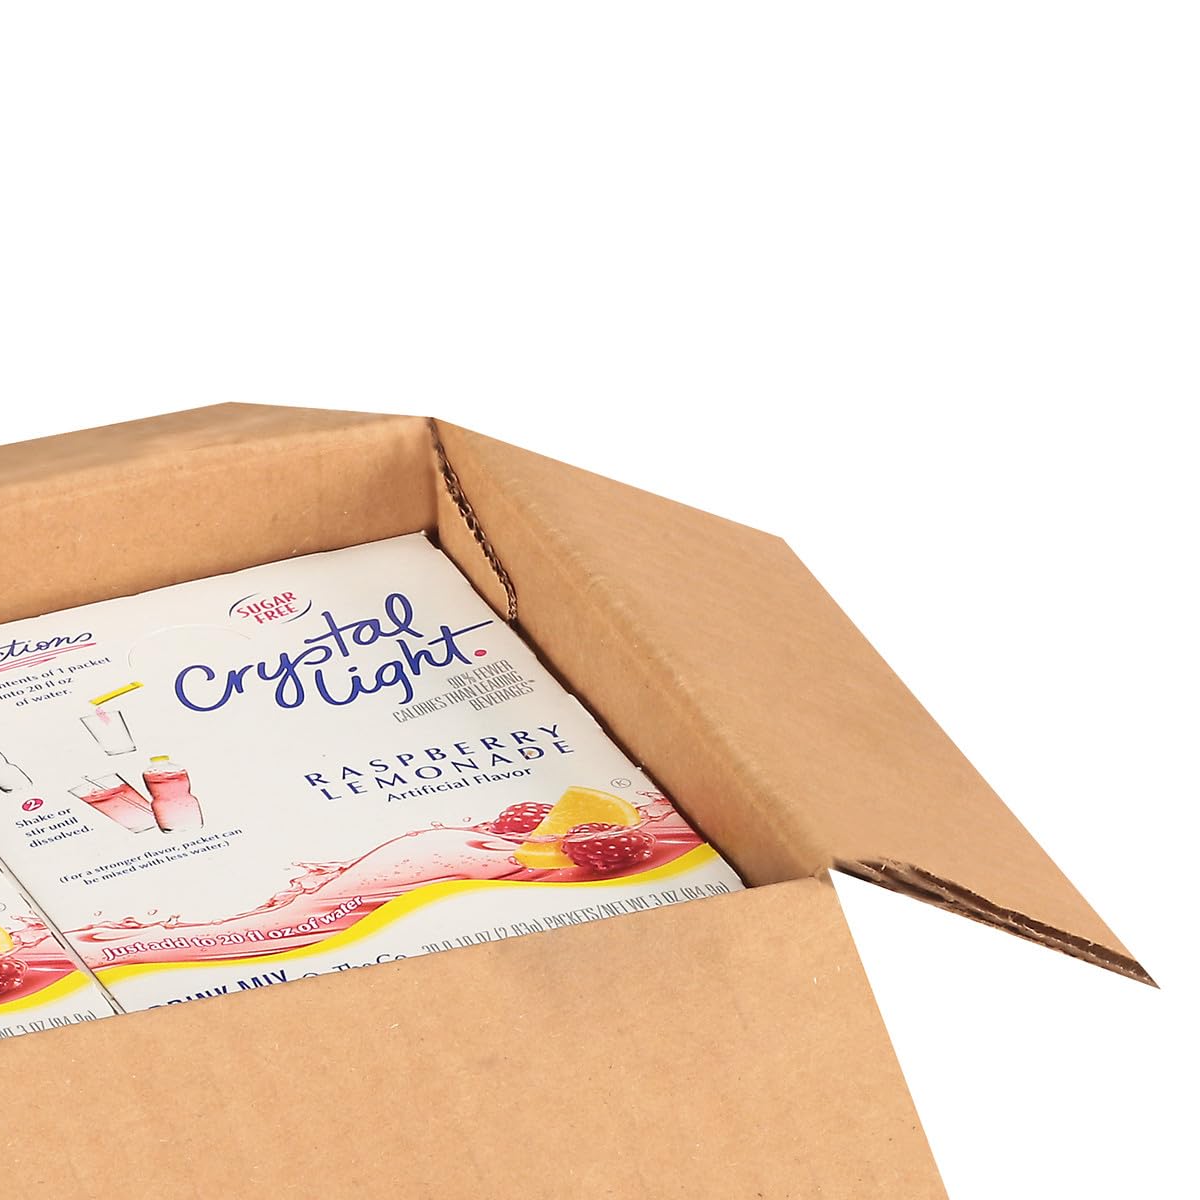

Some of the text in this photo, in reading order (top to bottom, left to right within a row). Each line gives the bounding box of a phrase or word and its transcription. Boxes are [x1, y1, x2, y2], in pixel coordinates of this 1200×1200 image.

[236, 591, 297, 619] SUGAR
[254, 603, 298, 625] FREE
[175, 593, 424, 712] Crystal
[42, 670, 54, 678] of
[68, 657, 111, 673] packet
[473, 660, 513, 681] FEWER
[16, 690, 72, 707] of water.
[29, 684, 42, 693] 20
[45, 679, 55, 687] fl
[393, 671, 523, 723] CALORIES THAN LEADING
[303, 724, 562, 787] RASPBERRY
[319, 741, 575, 801] LEMONADE
[388, 767, 532, 802] Artificial Flavor
[16, 808, 72, 829] Shake or
[25, 817, 78, 837] stir until
[29, 826, 94, 848] dissolved.
[59, 873, 85, 884] (For
[94, 855, 142, 873] stronger
[144, 846, 180, 859] flavor,
[182, 834, 220, 850] packet
[222, 829, 242, 838] can
[83, 840, 230, 886] be mixed with less water.)
[104, 896, 363, 961] Just add to 20 fl oz of water
